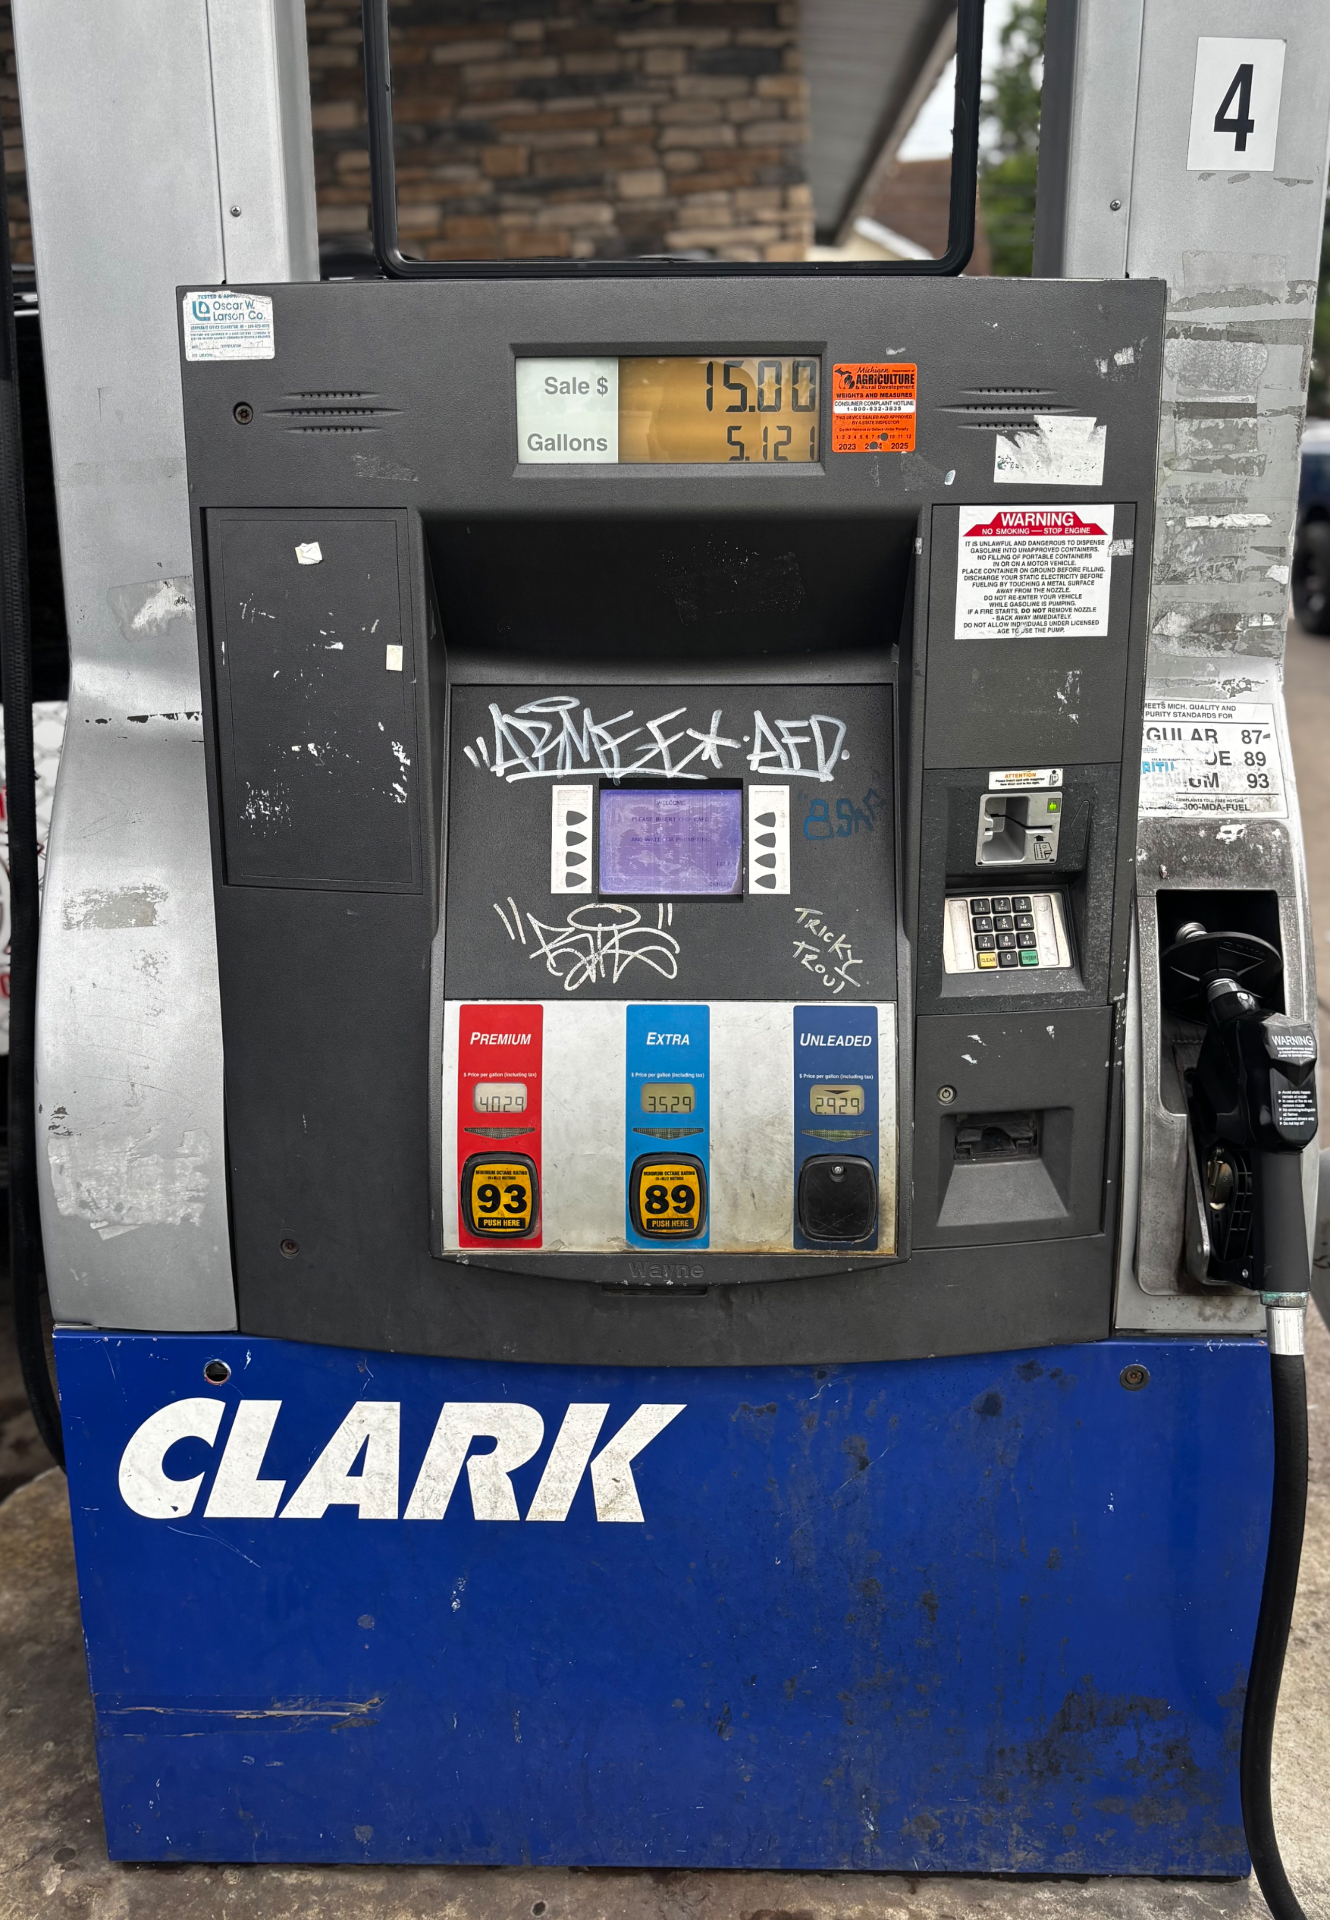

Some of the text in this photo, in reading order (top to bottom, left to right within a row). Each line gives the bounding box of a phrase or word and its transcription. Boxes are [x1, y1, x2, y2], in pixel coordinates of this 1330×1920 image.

[1213, 63, 1255, 152] 4
[213, 300, 255, 310] Oscar W.
[213, 311, 265, 321] Larson Co.
[544, 377, 608, 397] Sale $
[706, 360, 816, 412] 15.00
[527, 434, 608, 452] Gallons
[727, 426, 816, 461] 5.121
[1001, 513, 1074, 526] WARNING
[1244, 751, 1266, 766] 89
[1247, 773, 1269, 788] 93
[795, 908, 863, 987] TRICKY
[470, 1032, 531, 1045] PREMIUM
[646, 1032, 690, 1045] EXTRA
[800, 1033, 872, 1046] UNLEADED
[1272, 1036, 1314, 1046] WARNING
[480, 1096, 524, 1112] 4.029
[648, 1096, 691, 1113] 3.529
[815, 1098, 859, 1114] 2.929
[477, 1184, 527, 1213] 93
[645, 1184, 695, 1214] 89
[628, 1262, 704, 1278] Wayne
[118, 1397, 688, 1522] CLARK
